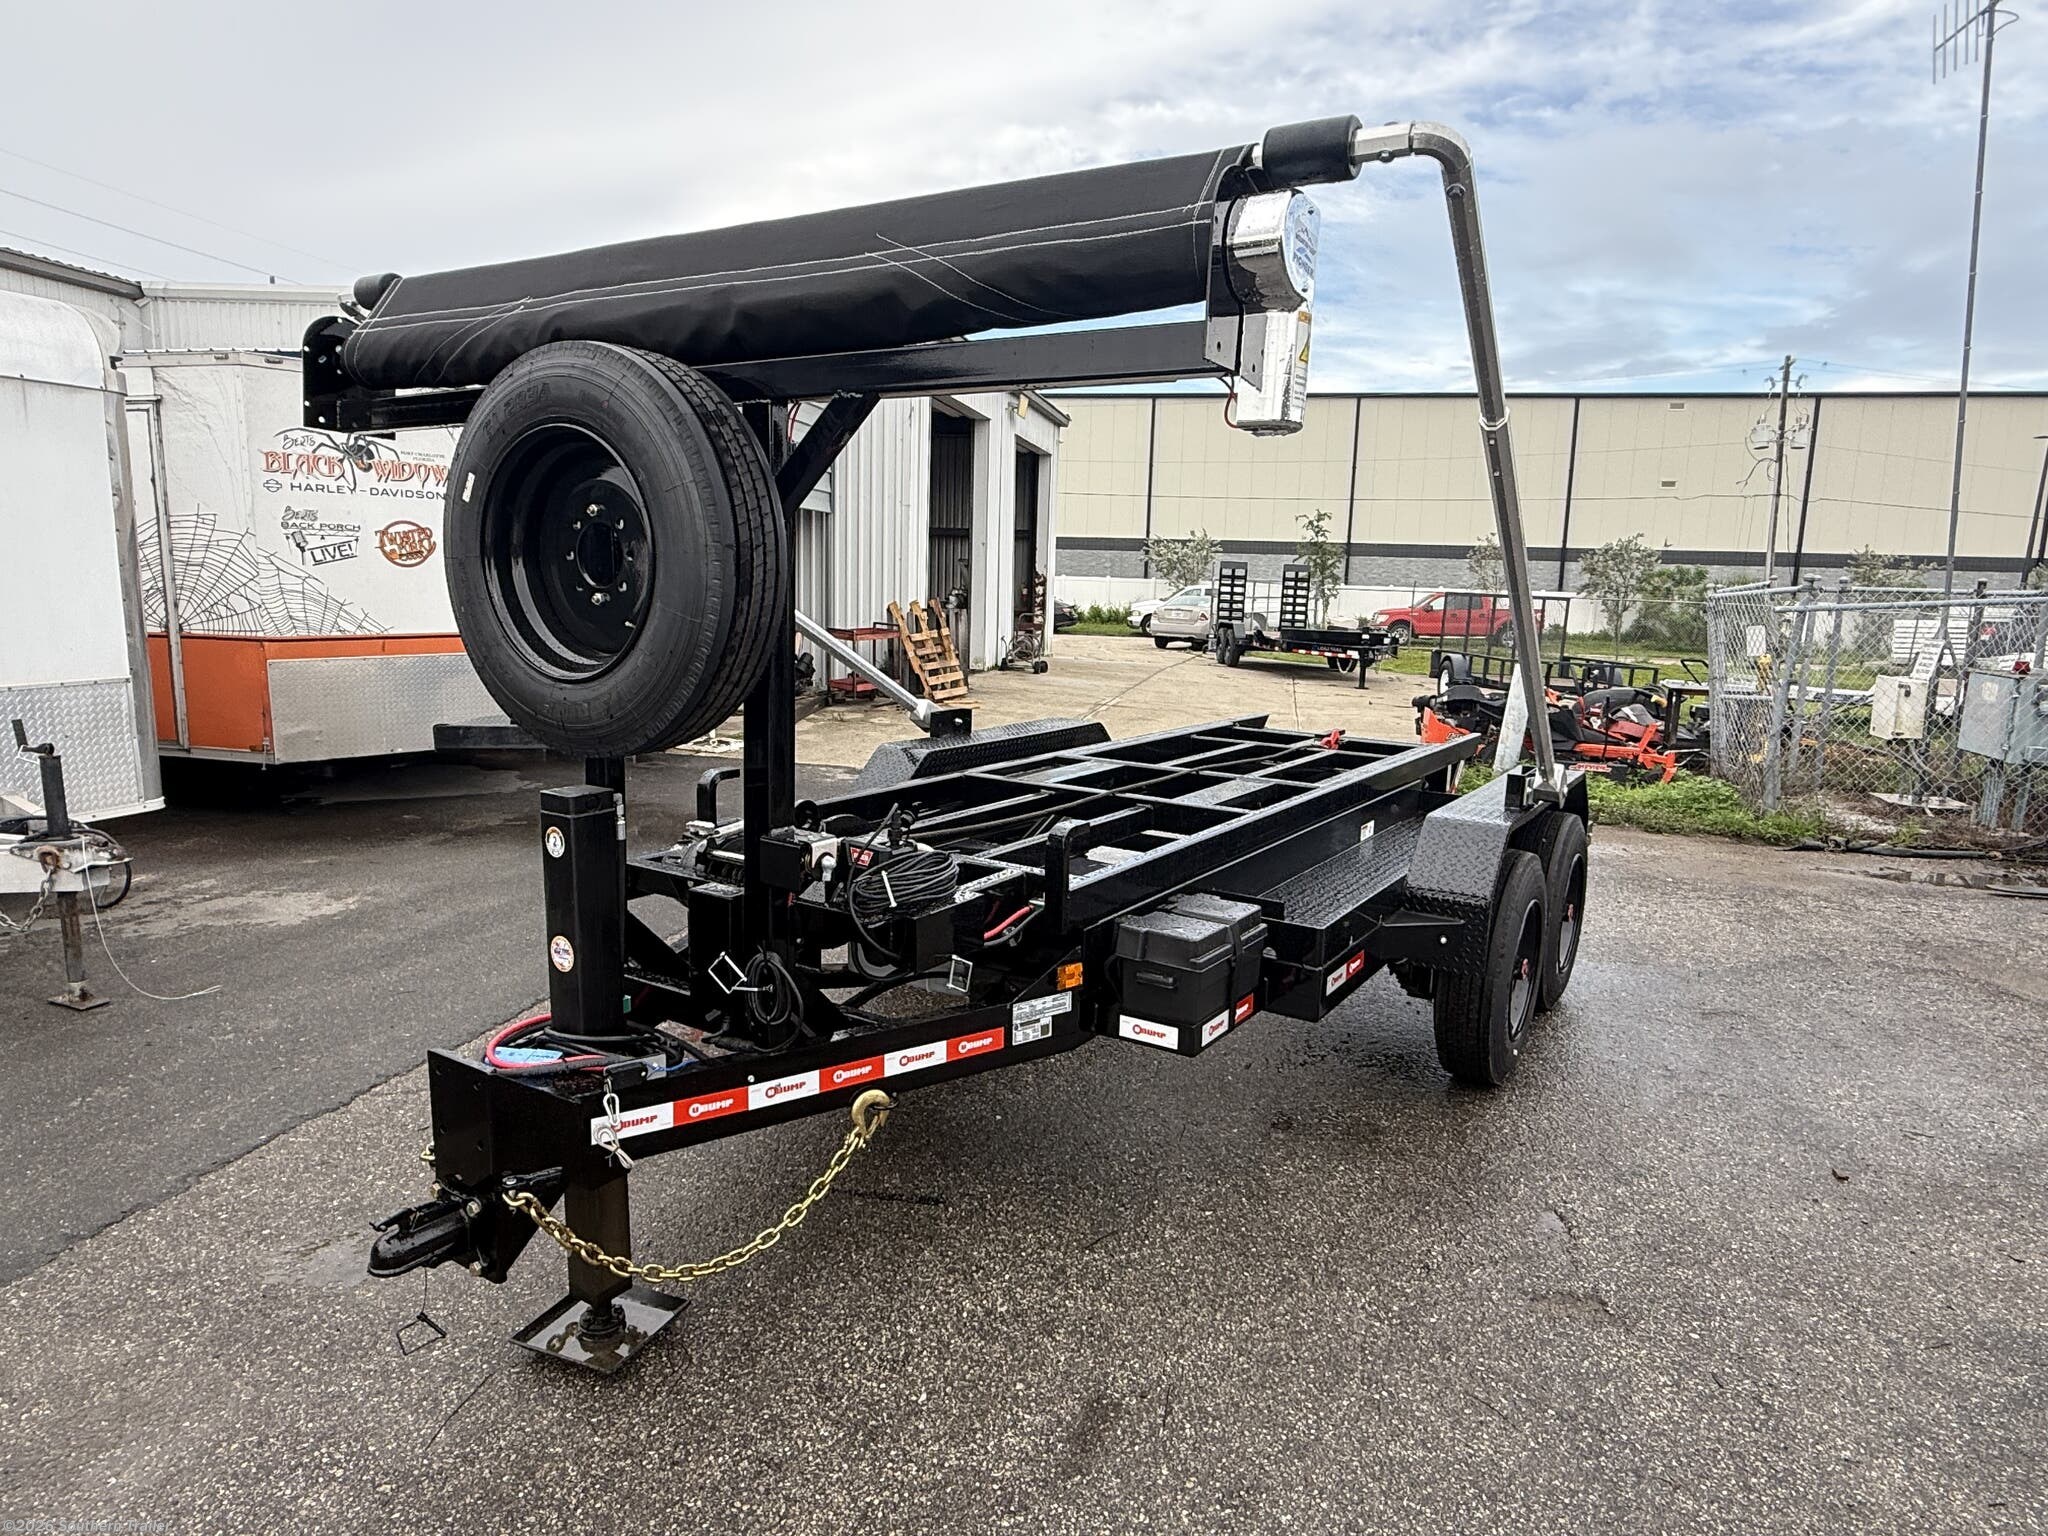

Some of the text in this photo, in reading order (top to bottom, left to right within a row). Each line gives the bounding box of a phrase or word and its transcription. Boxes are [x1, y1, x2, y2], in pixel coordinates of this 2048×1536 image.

[262, 450, 449, 488] BLACK WIDOW
[281, 521, 361, 532] BACK PORCH
[310, 542, 355, 564] LIVE!
